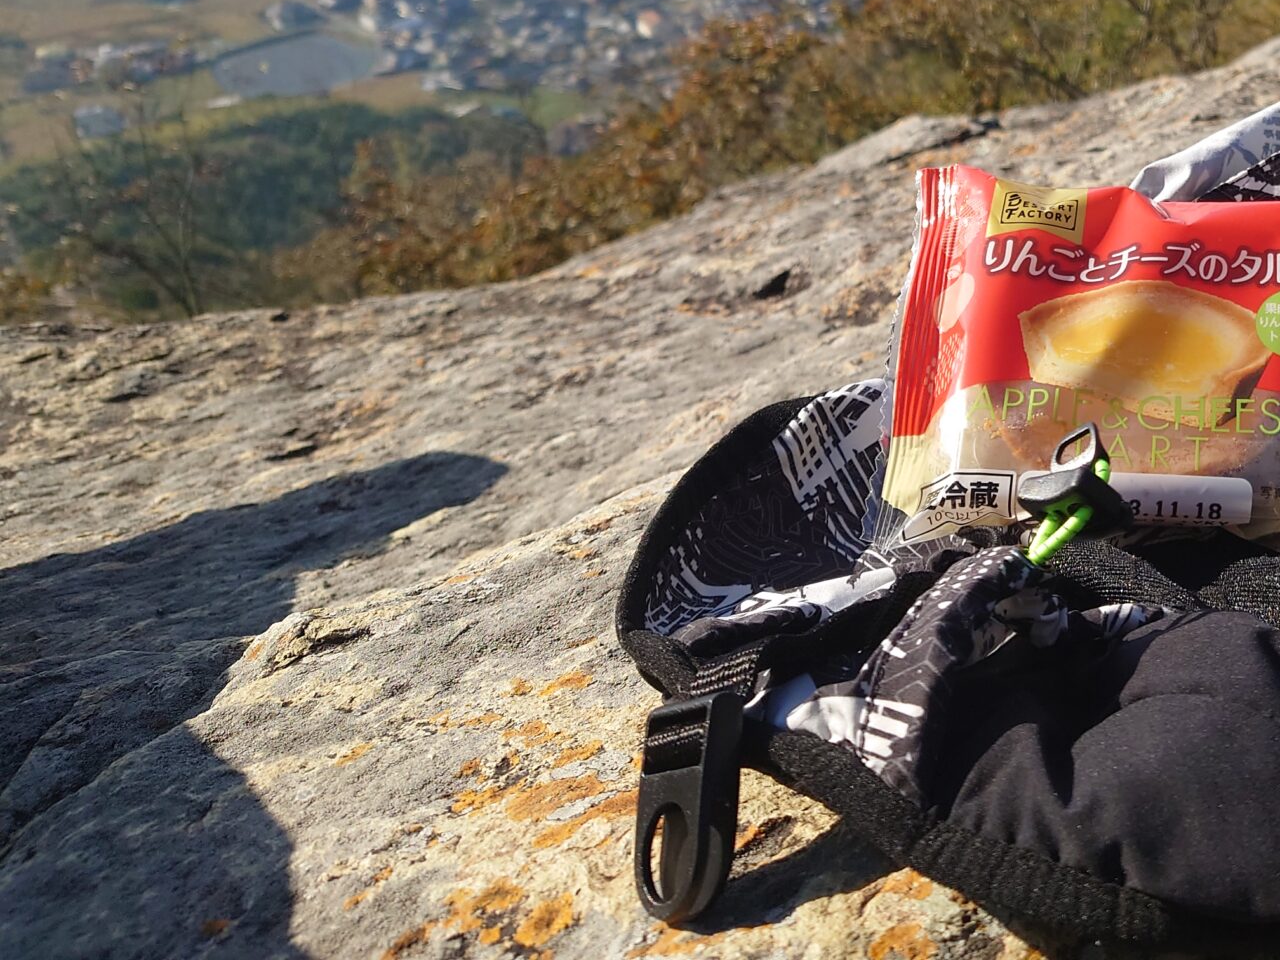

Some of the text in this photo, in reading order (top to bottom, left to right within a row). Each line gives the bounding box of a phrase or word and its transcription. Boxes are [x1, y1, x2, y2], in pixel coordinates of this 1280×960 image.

[1005, 207, 1072, 223] FACTORY
[966, 384, 1094, 427] APPLE
[1102, 397, 1129, 431] &
